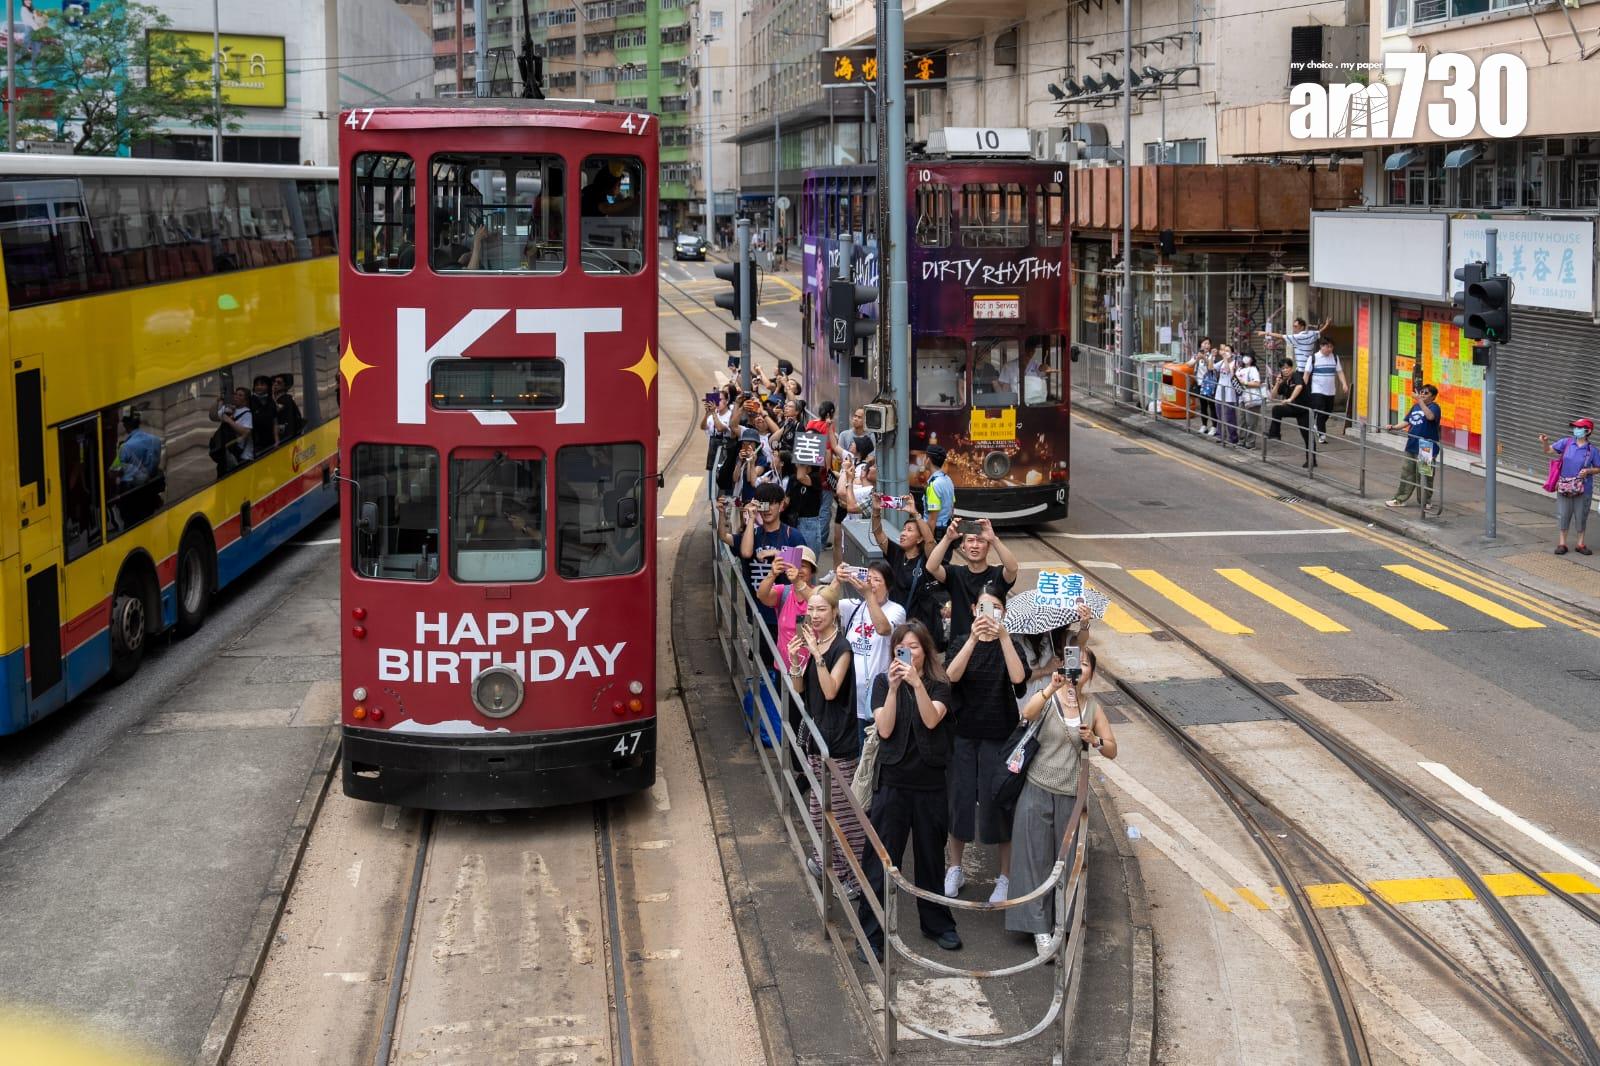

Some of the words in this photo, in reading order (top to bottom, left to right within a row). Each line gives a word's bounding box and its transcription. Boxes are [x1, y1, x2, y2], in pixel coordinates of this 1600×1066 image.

[834, 56, 936, 80] 海悅宴
[344, 108, 374, 130] 47
[620, 113, 650, 136] 47
[975, 130, 1000, 150] 10
[919, 169, 931, 182] 10
[1053, 170, 1063, 183] 10
[1463, 229, 1507, 241] HARMNY
[1510, 231, 1544, 242] BEAUTY
[1547, 232, 1582, 244] HOUSE
[922, 257, 982, 286] DIRTY
[982, 256, 1062, 285] RHYTHM
[975, 301, 986, 310] Not
[988, 301, 994, 309] in
[995, 301, 1018, 309] Service
[396, 307, 623, 425] KT
[1056, 488, 1065, 502] 10
[1035, 594, 1062, 608] Keung
[1063, 597, 1075, 608] To
[415, 607, 590, 646] HAPPY
[378, 641, 628, 684] BIRTHDAY
[612, 731, 642, 757] 47
